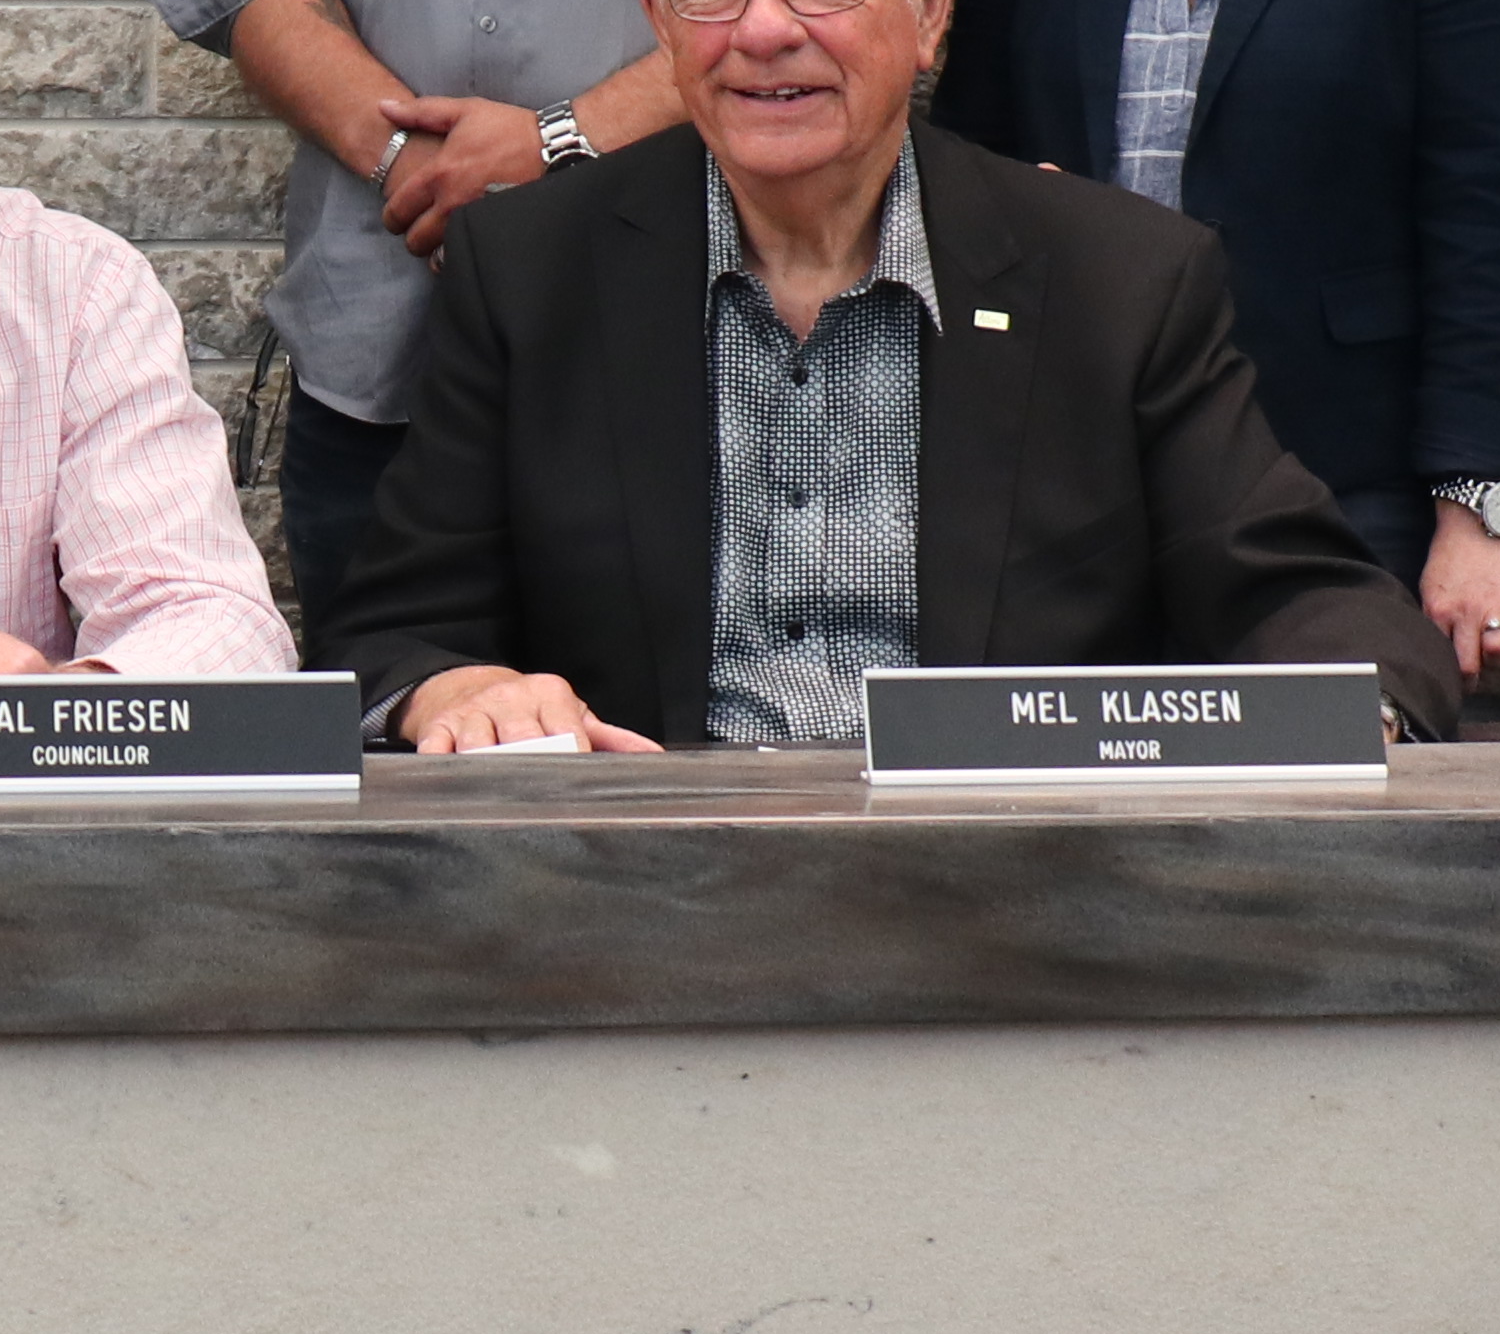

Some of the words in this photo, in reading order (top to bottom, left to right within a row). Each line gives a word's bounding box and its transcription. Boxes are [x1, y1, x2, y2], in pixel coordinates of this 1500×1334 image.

[52, 698, 191, 733] FRIESEN
[1011, 690, 1078, 725] MEL
[1100, 689, 1242, 724] KLASSEN
[31, 744, 150, 766] COUNCILLOR
[1098, 739, 1161, 761] MAYOR
